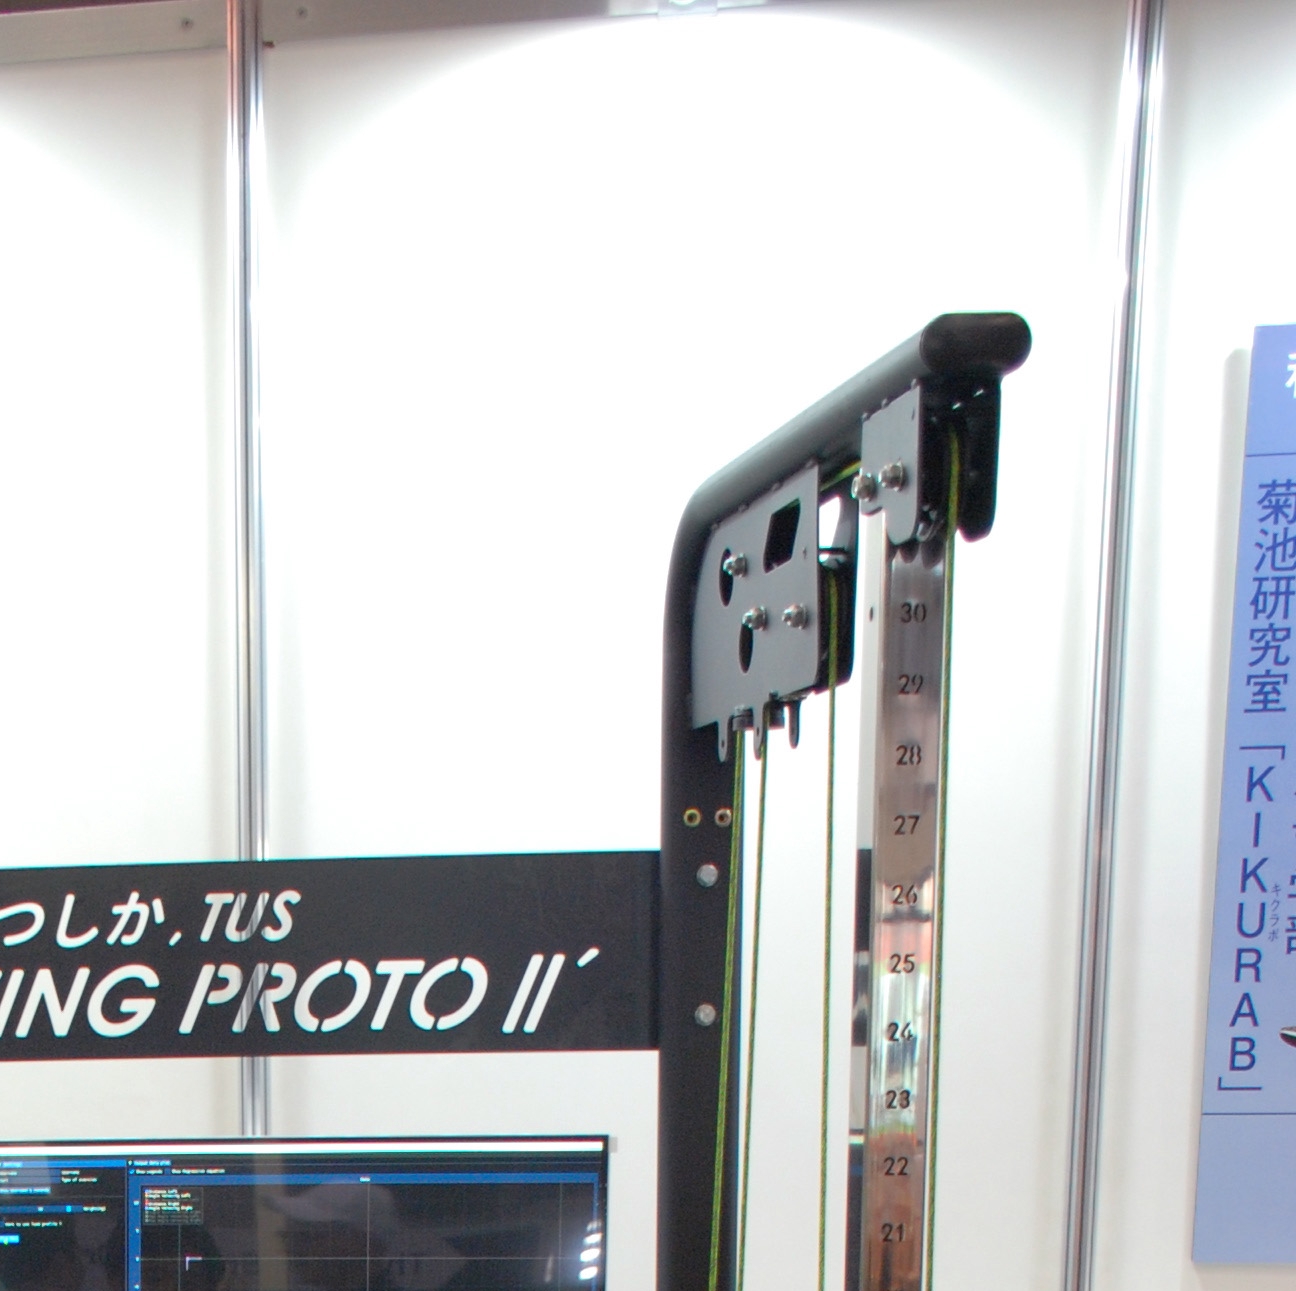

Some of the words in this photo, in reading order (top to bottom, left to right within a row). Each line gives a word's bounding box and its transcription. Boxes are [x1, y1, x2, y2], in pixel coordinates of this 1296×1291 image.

[901, 602, 926, 624] 30
[898, 674, 924, 696] 29
[896, 745, 922, 766] 28
[894, 815, 920, 836] 27
[892, 885, 917, 906] 26
[199, 890, 302, 943] TUS
[890, 954, 915, 974] 25
[178, 957, 488, 1036] PROTO
[888, 1022, 913, 1042] 24
[886, 1089, 911, 1110] 23
[884, 1157, 908, 1176] 22
[881, 1223, 905, 1242] 21
